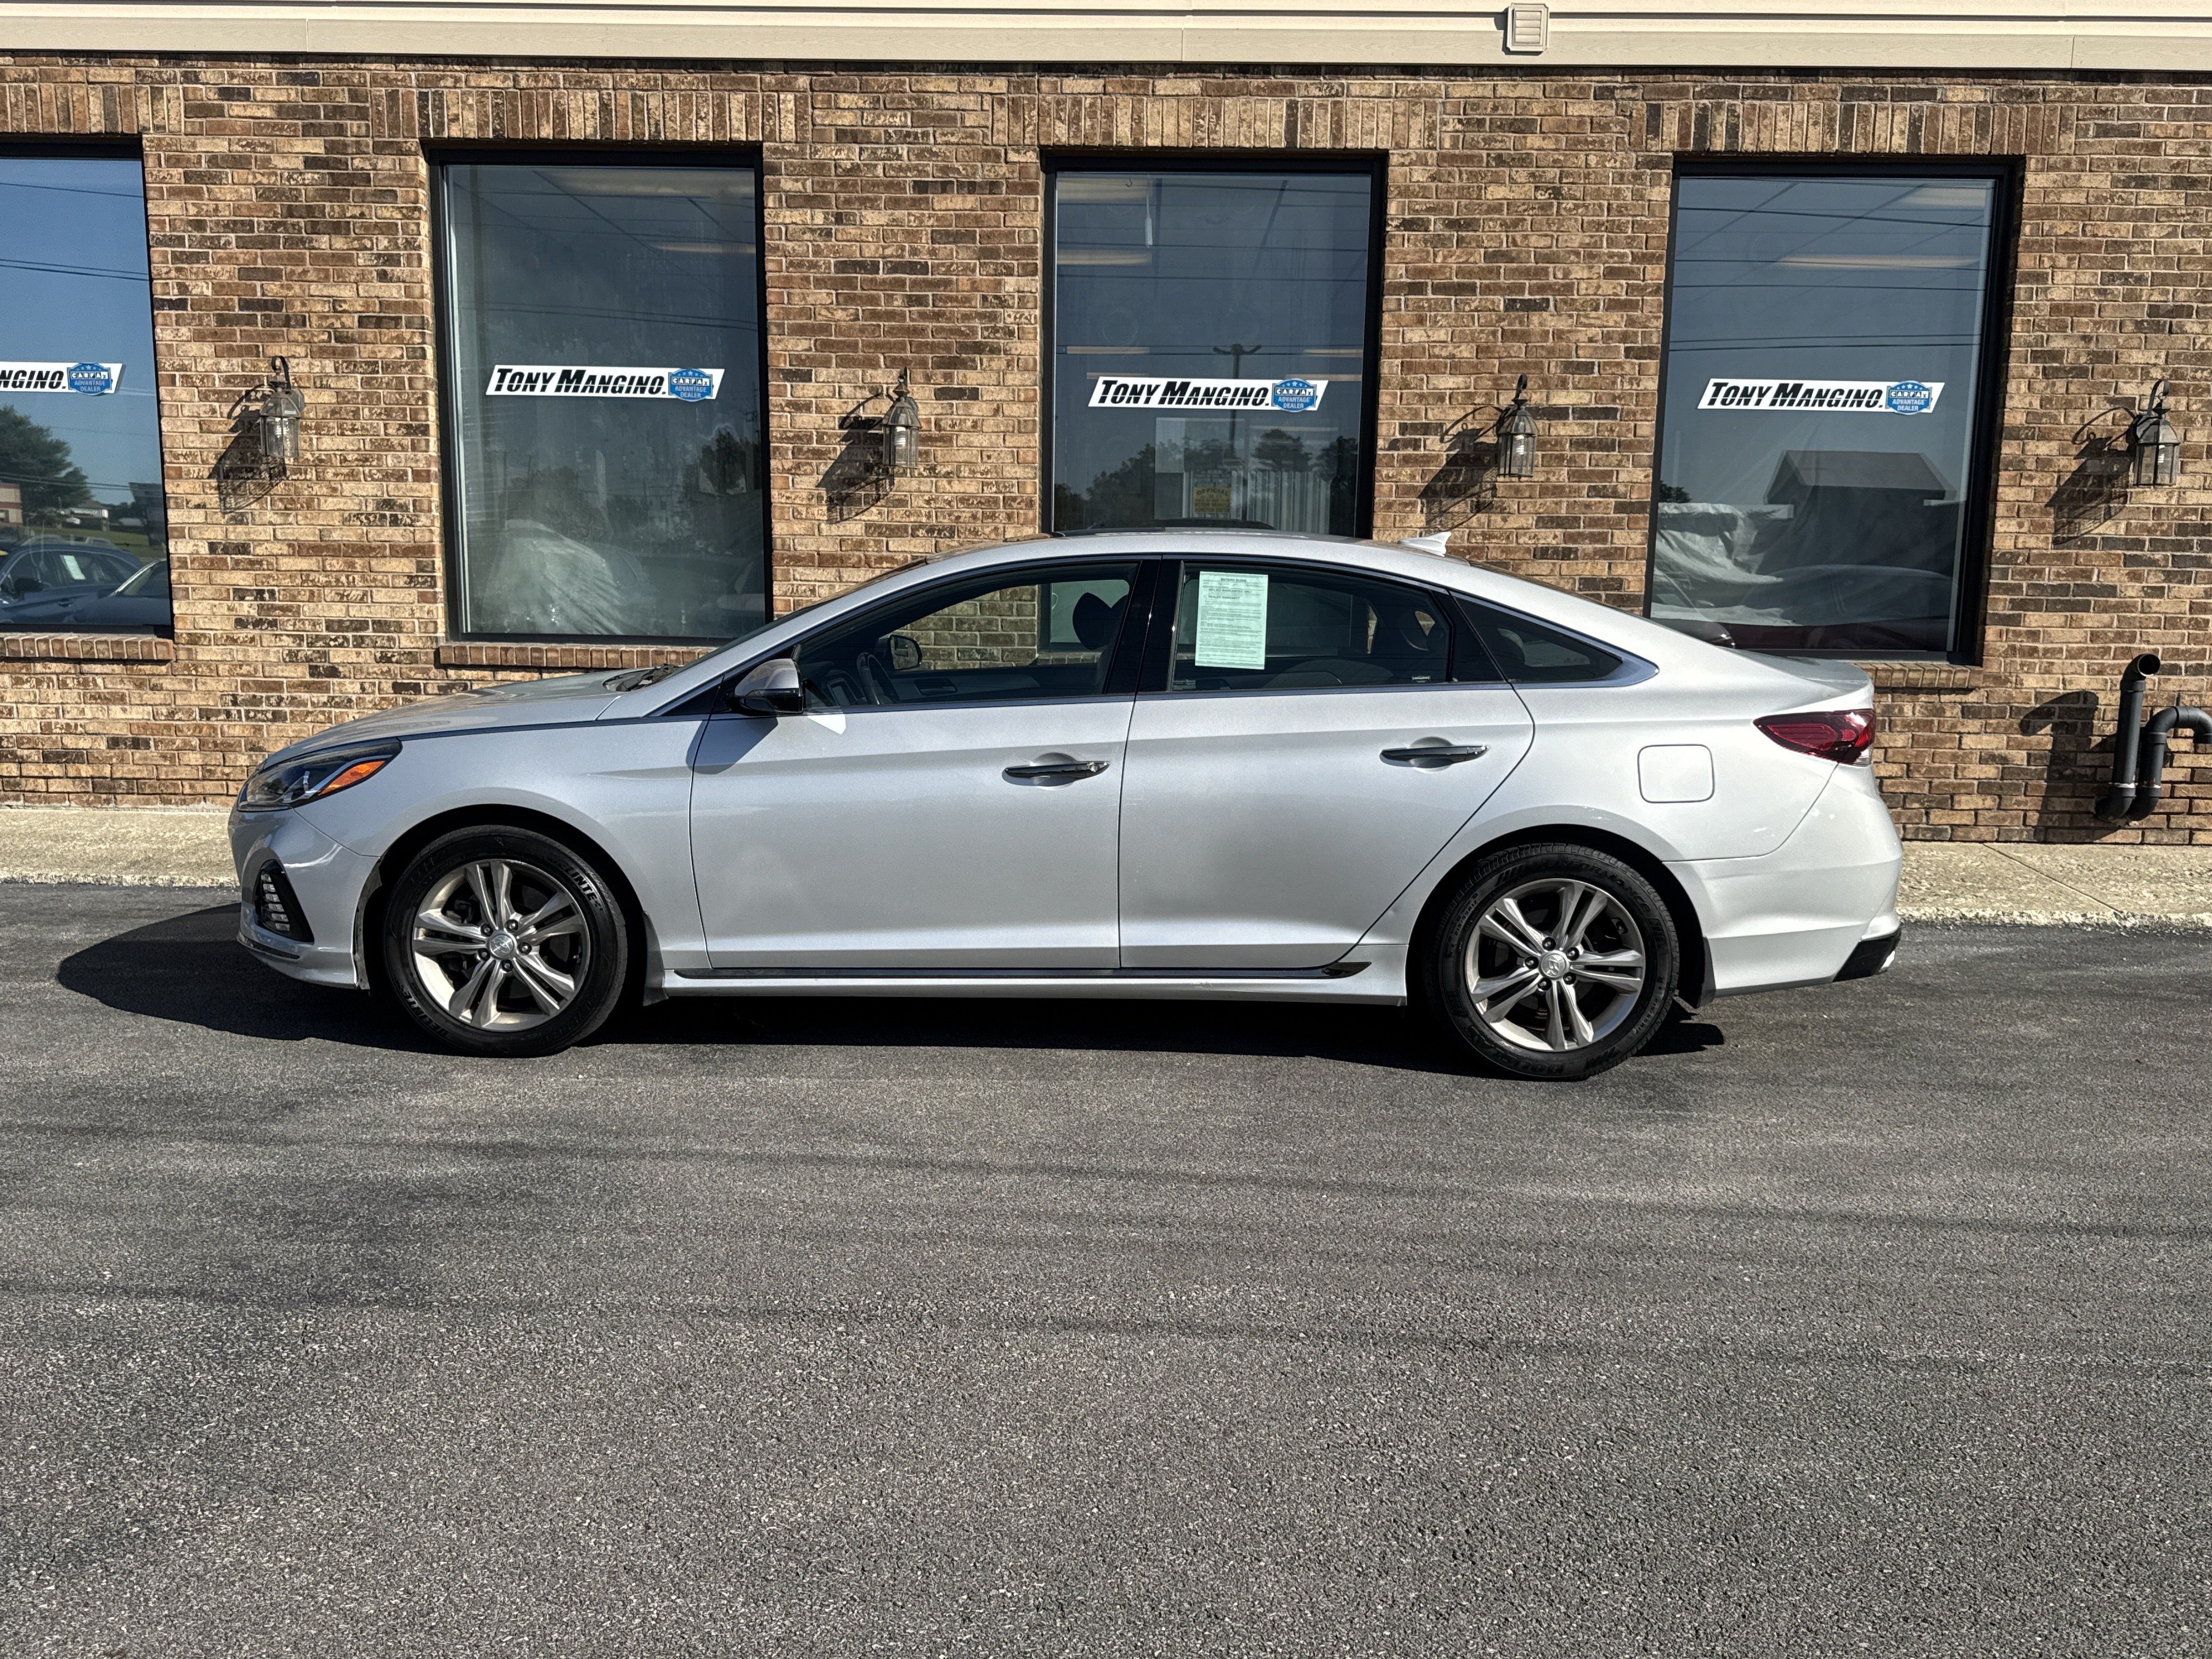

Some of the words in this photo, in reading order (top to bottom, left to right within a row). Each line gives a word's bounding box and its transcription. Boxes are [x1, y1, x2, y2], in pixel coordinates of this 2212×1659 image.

[494, 368, 556, 393] TONY
[673, 377, 709, 386] CARFAX
[1098, 380, 1161, 405] TONY
[1707, 382, 1773, 407] TONY
[1197, 488, 1229, 496] OFFICIAL
